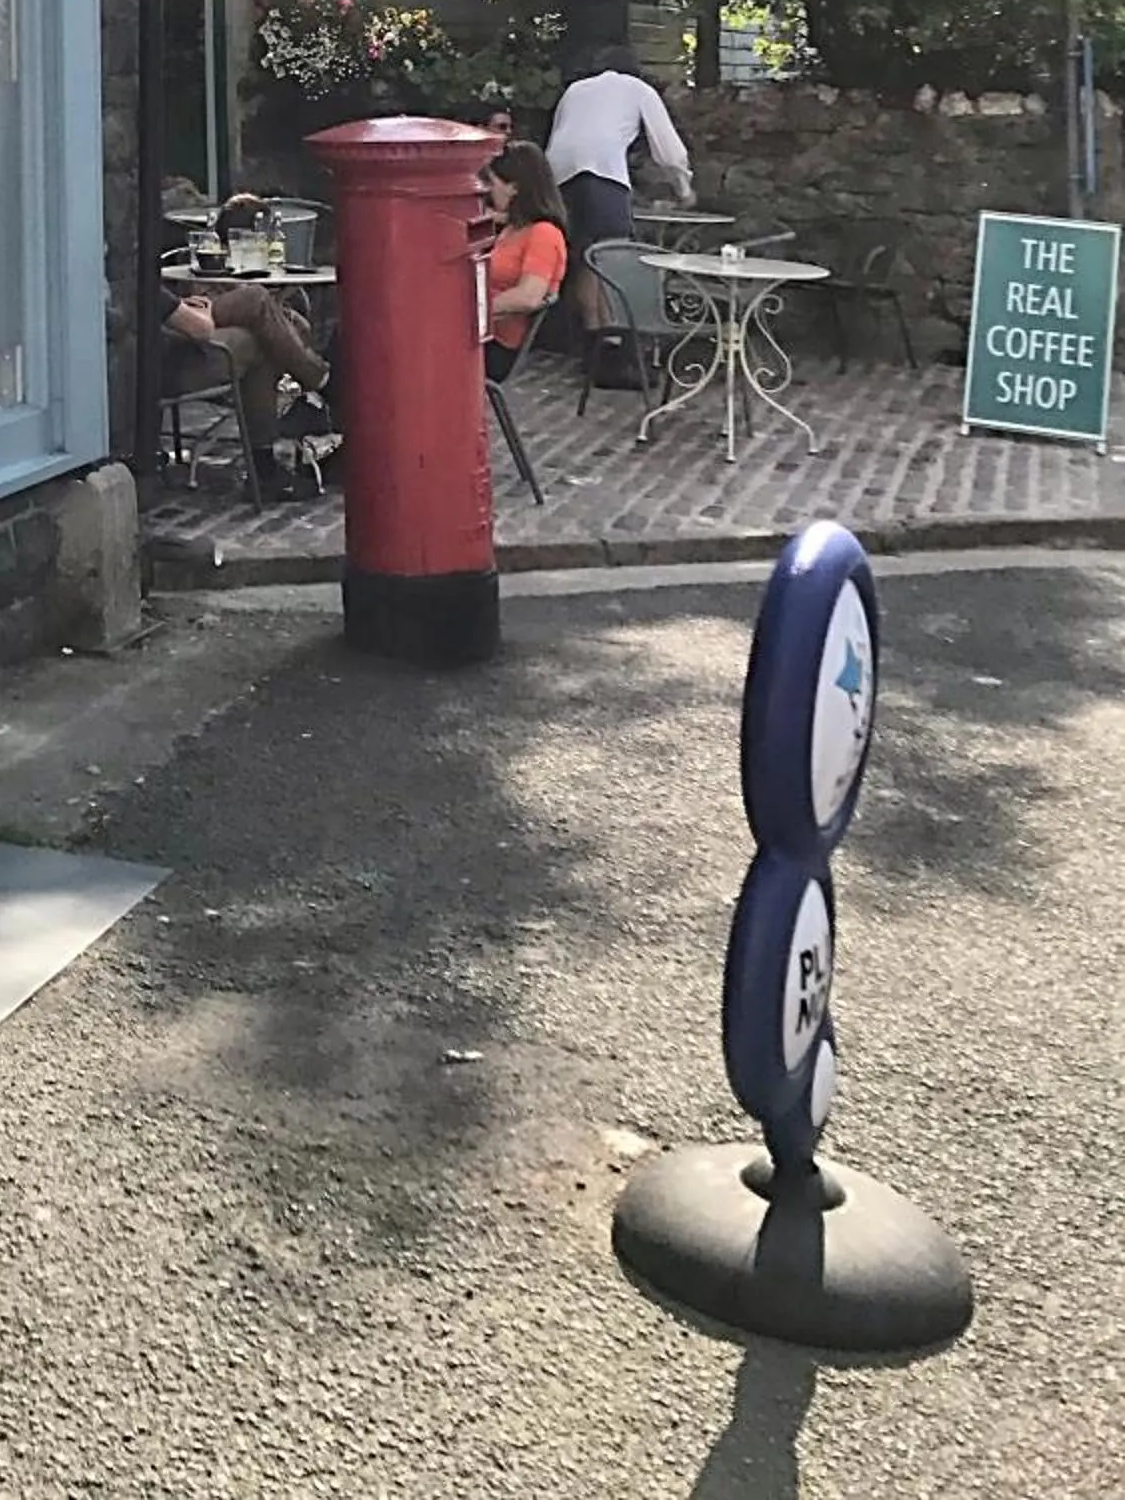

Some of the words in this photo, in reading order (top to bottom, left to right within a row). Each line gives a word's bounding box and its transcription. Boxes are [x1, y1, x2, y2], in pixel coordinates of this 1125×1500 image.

[1020, 238, 1075, 274] THE
[1006, 281, 1079, 319] REAL
[986, 325, 1095, 367] COFFEE
[996, 371, 1076, 410] SHOP
